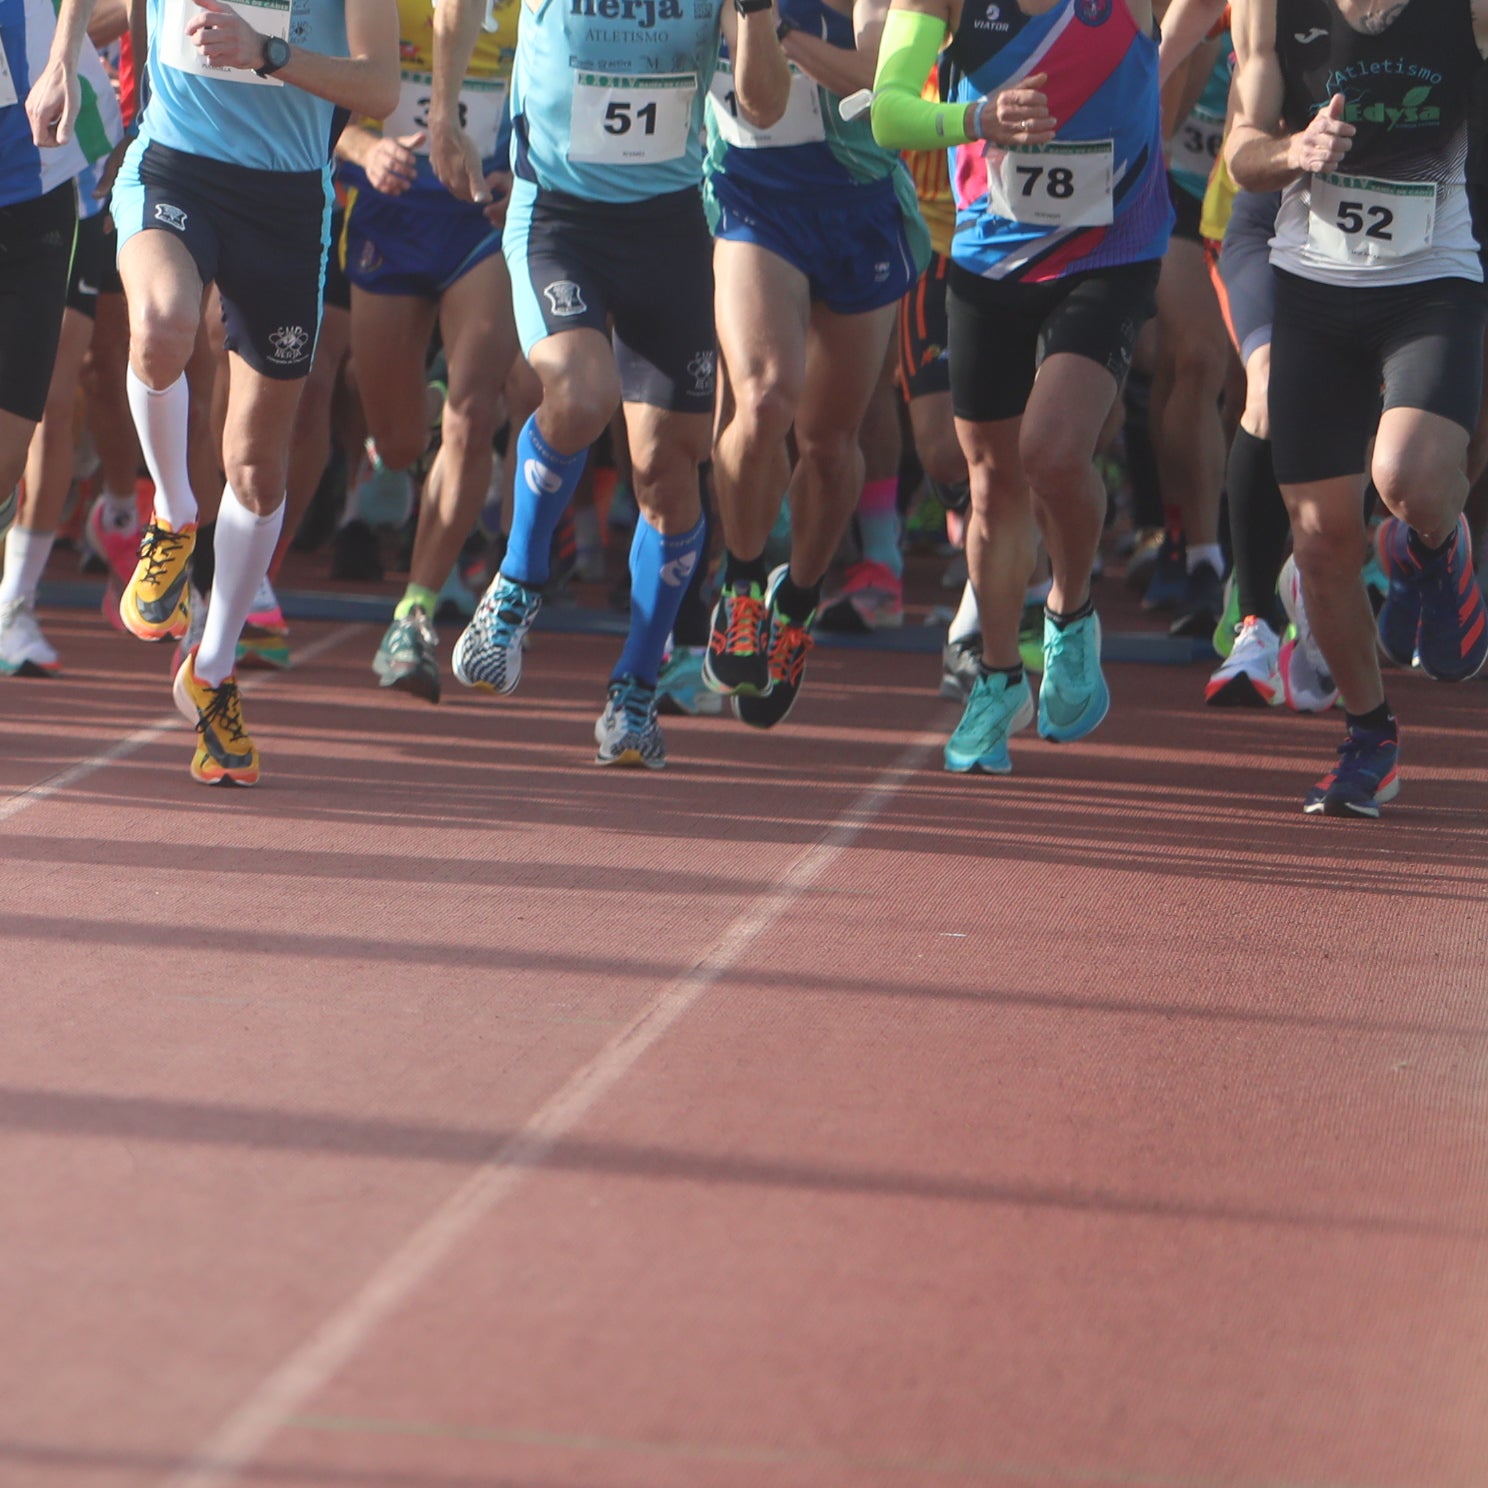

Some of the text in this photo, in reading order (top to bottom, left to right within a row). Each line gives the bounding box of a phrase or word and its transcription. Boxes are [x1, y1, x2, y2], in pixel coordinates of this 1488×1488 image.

[585, 28, 669, 43] ATLETISMO
[973, 19, 1010, 33] VIATOR
[1334, 57, 1442, 86] Atletismo
[603, 101, 657, 137] 51
[1015, 165, 1075, 199] 78
[1335, 201, 1394, 241] 52
